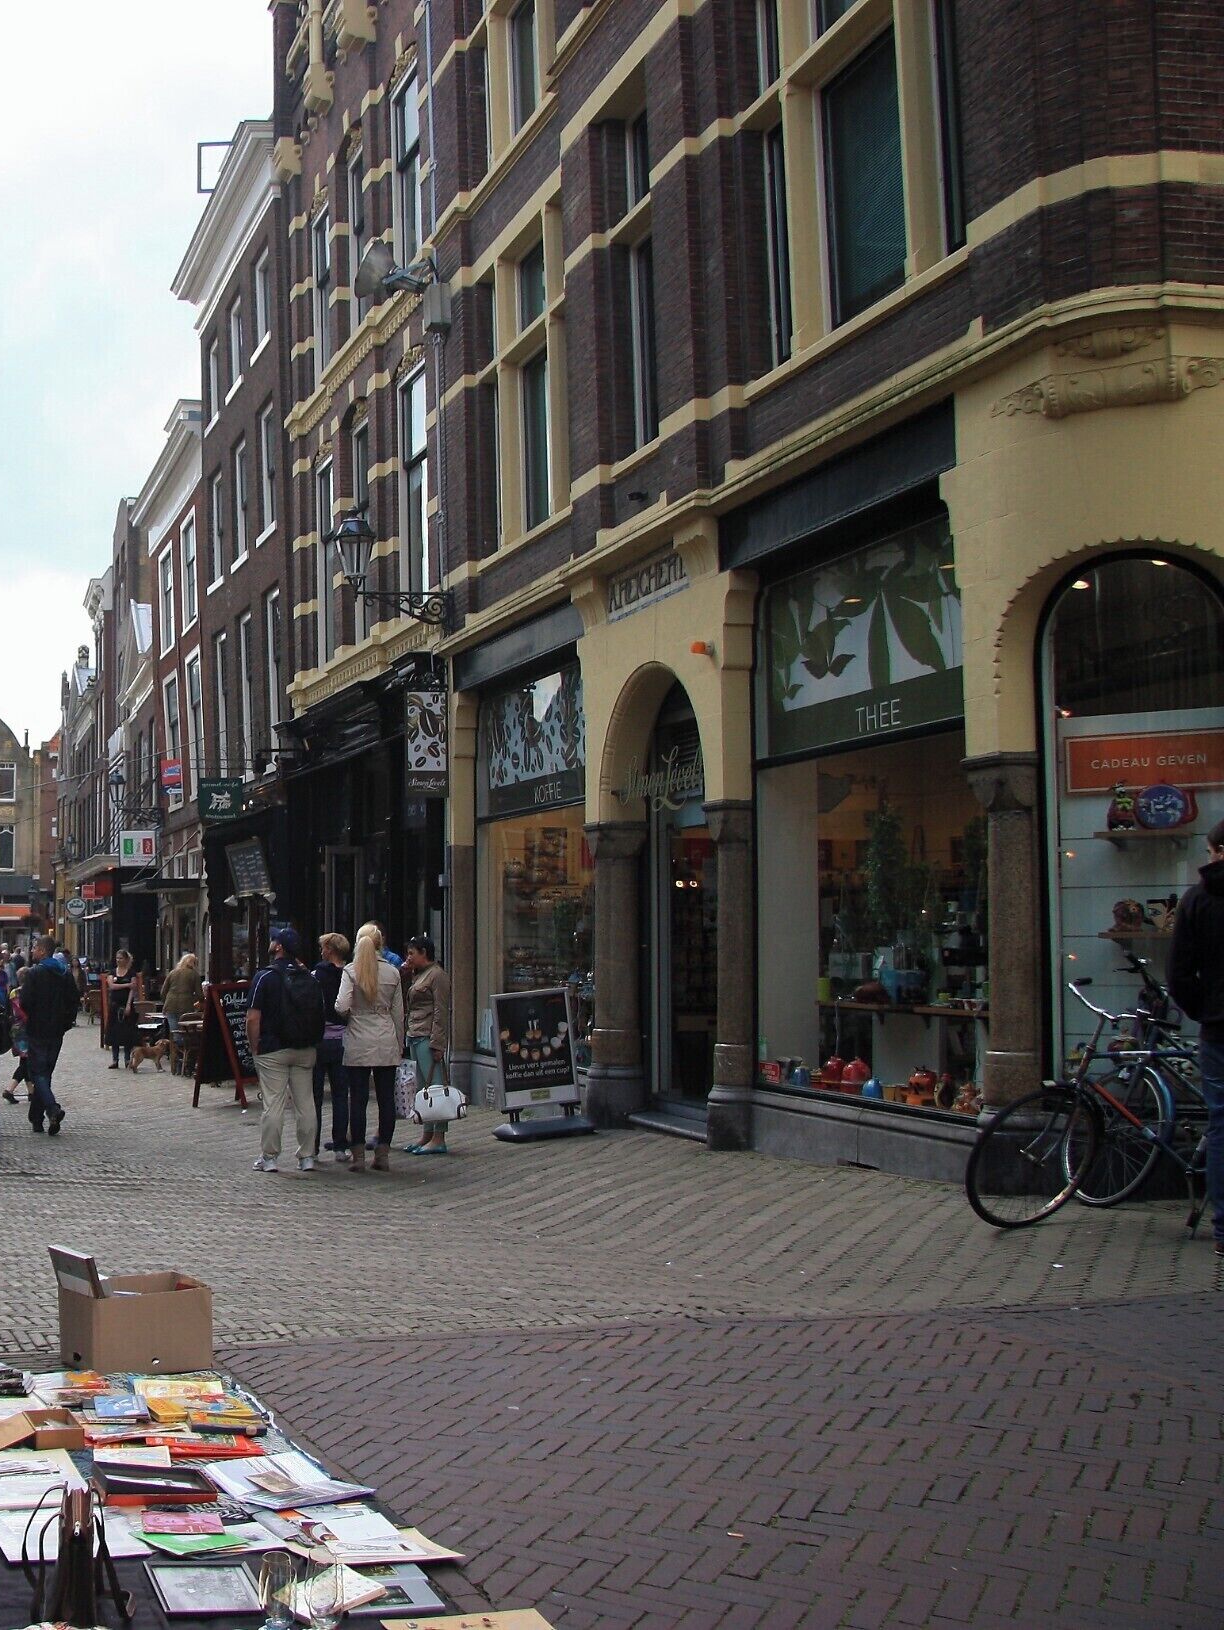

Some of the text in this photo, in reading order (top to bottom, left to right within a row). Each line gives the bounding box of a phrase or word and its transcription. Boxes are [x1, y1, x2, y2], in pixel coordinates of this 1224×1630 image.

[855, 698, 901, 733] THEE
[1090, 753, 1208, 770] CADEAU GEVEN
[534, 781, 562, 804] KOFFIE
